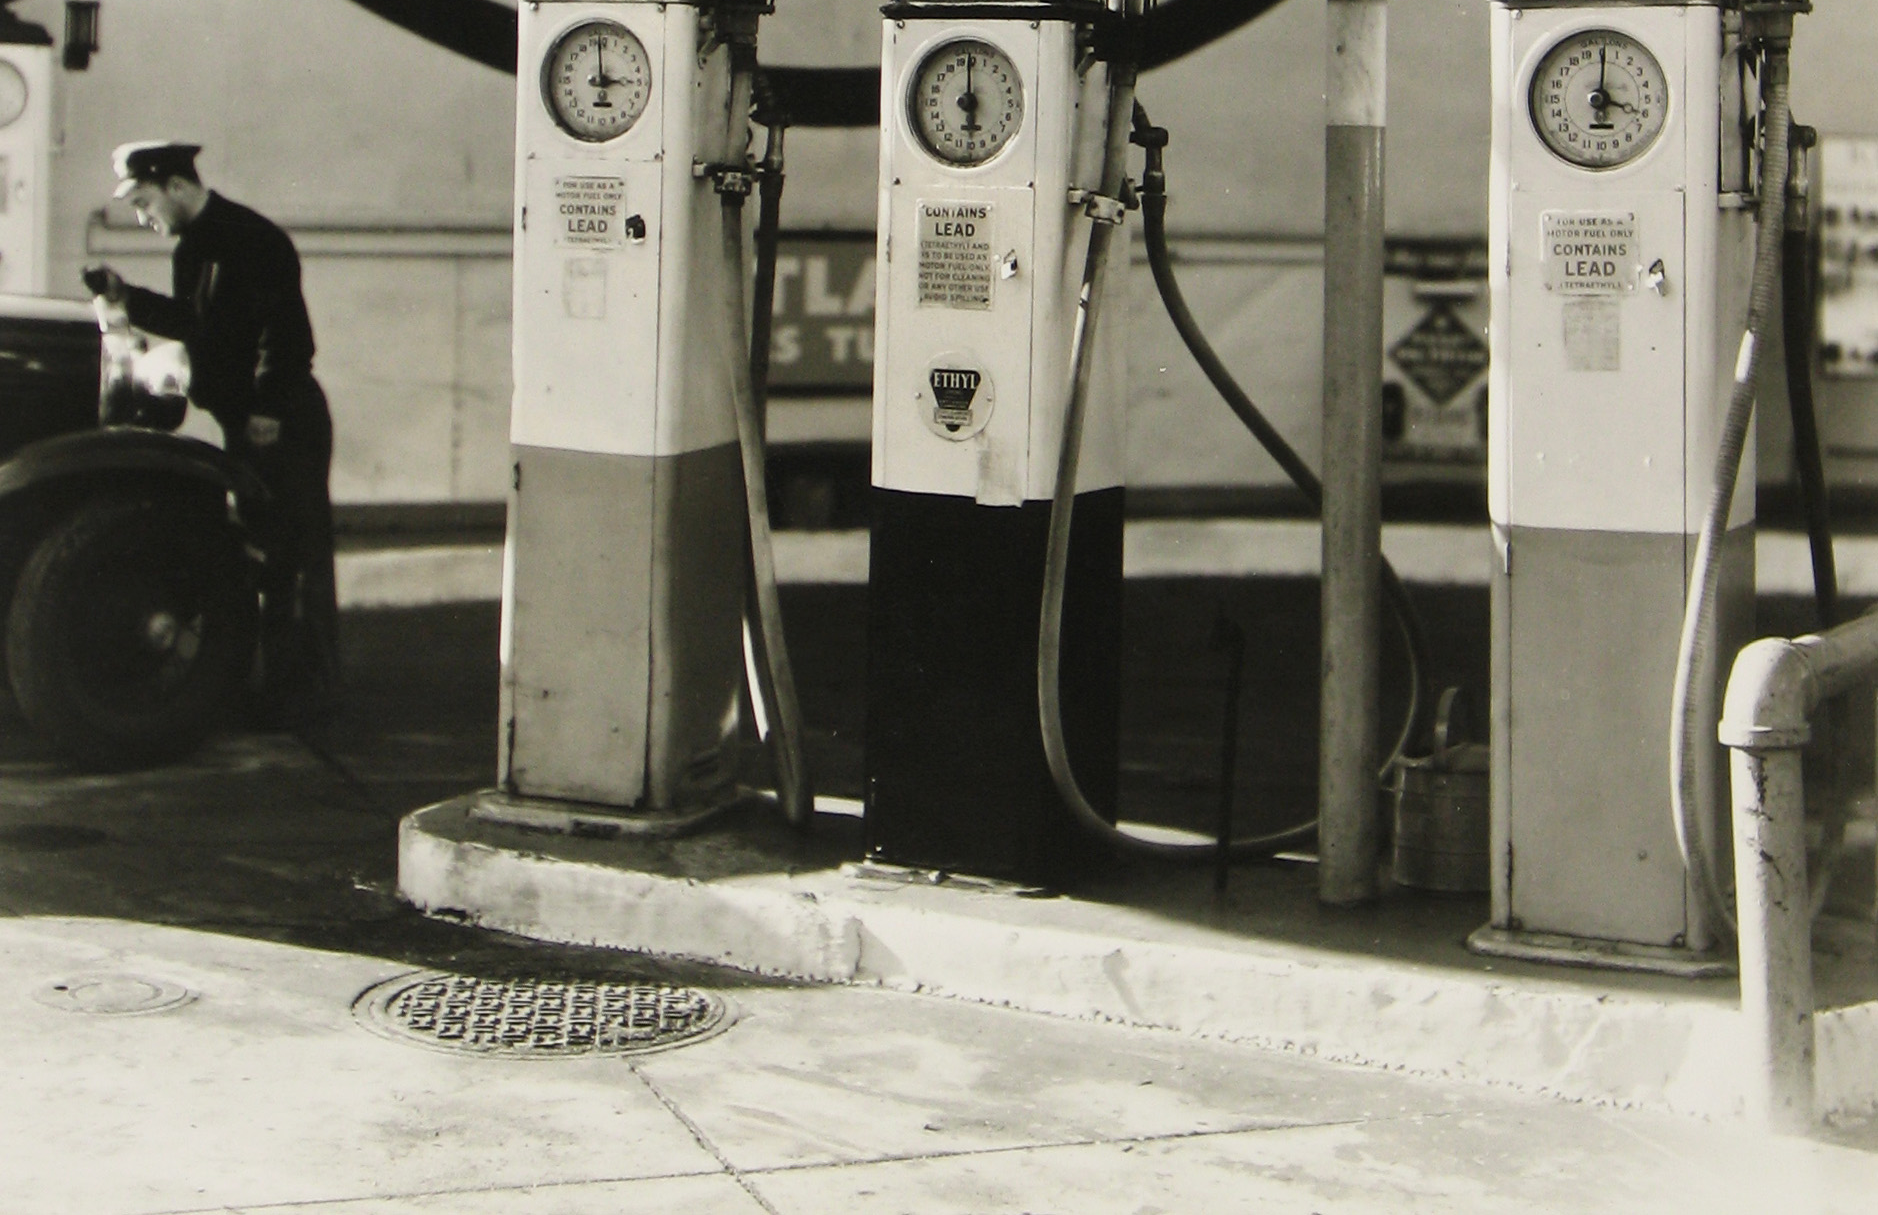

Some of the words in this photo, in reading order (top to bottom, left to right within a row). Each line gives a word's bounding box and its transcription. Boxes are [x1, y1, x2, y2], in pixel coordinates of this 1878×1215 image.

[559, 204, 616, 216] CONTAINS
[925, 207, 987, 219] CONTAINS
[568, 219, 608, 233] LEAD
[1579, 217, 1597, 226] USE
[1601, 217, 1613, 226] AS
[935, 222, 975, 237] LEAD
[1584, 229, 1606, 238] FUEL
[1610, 229, 1634, 238] ONLY
[972, 242, 990, 251] AND
[1553, 243, 1627, 256] CONTAINS
[955, 252, 975, 261] USED
[1565, 260, 1616, 277] LEAD
[933, 372, 976, 389] ETHYL
